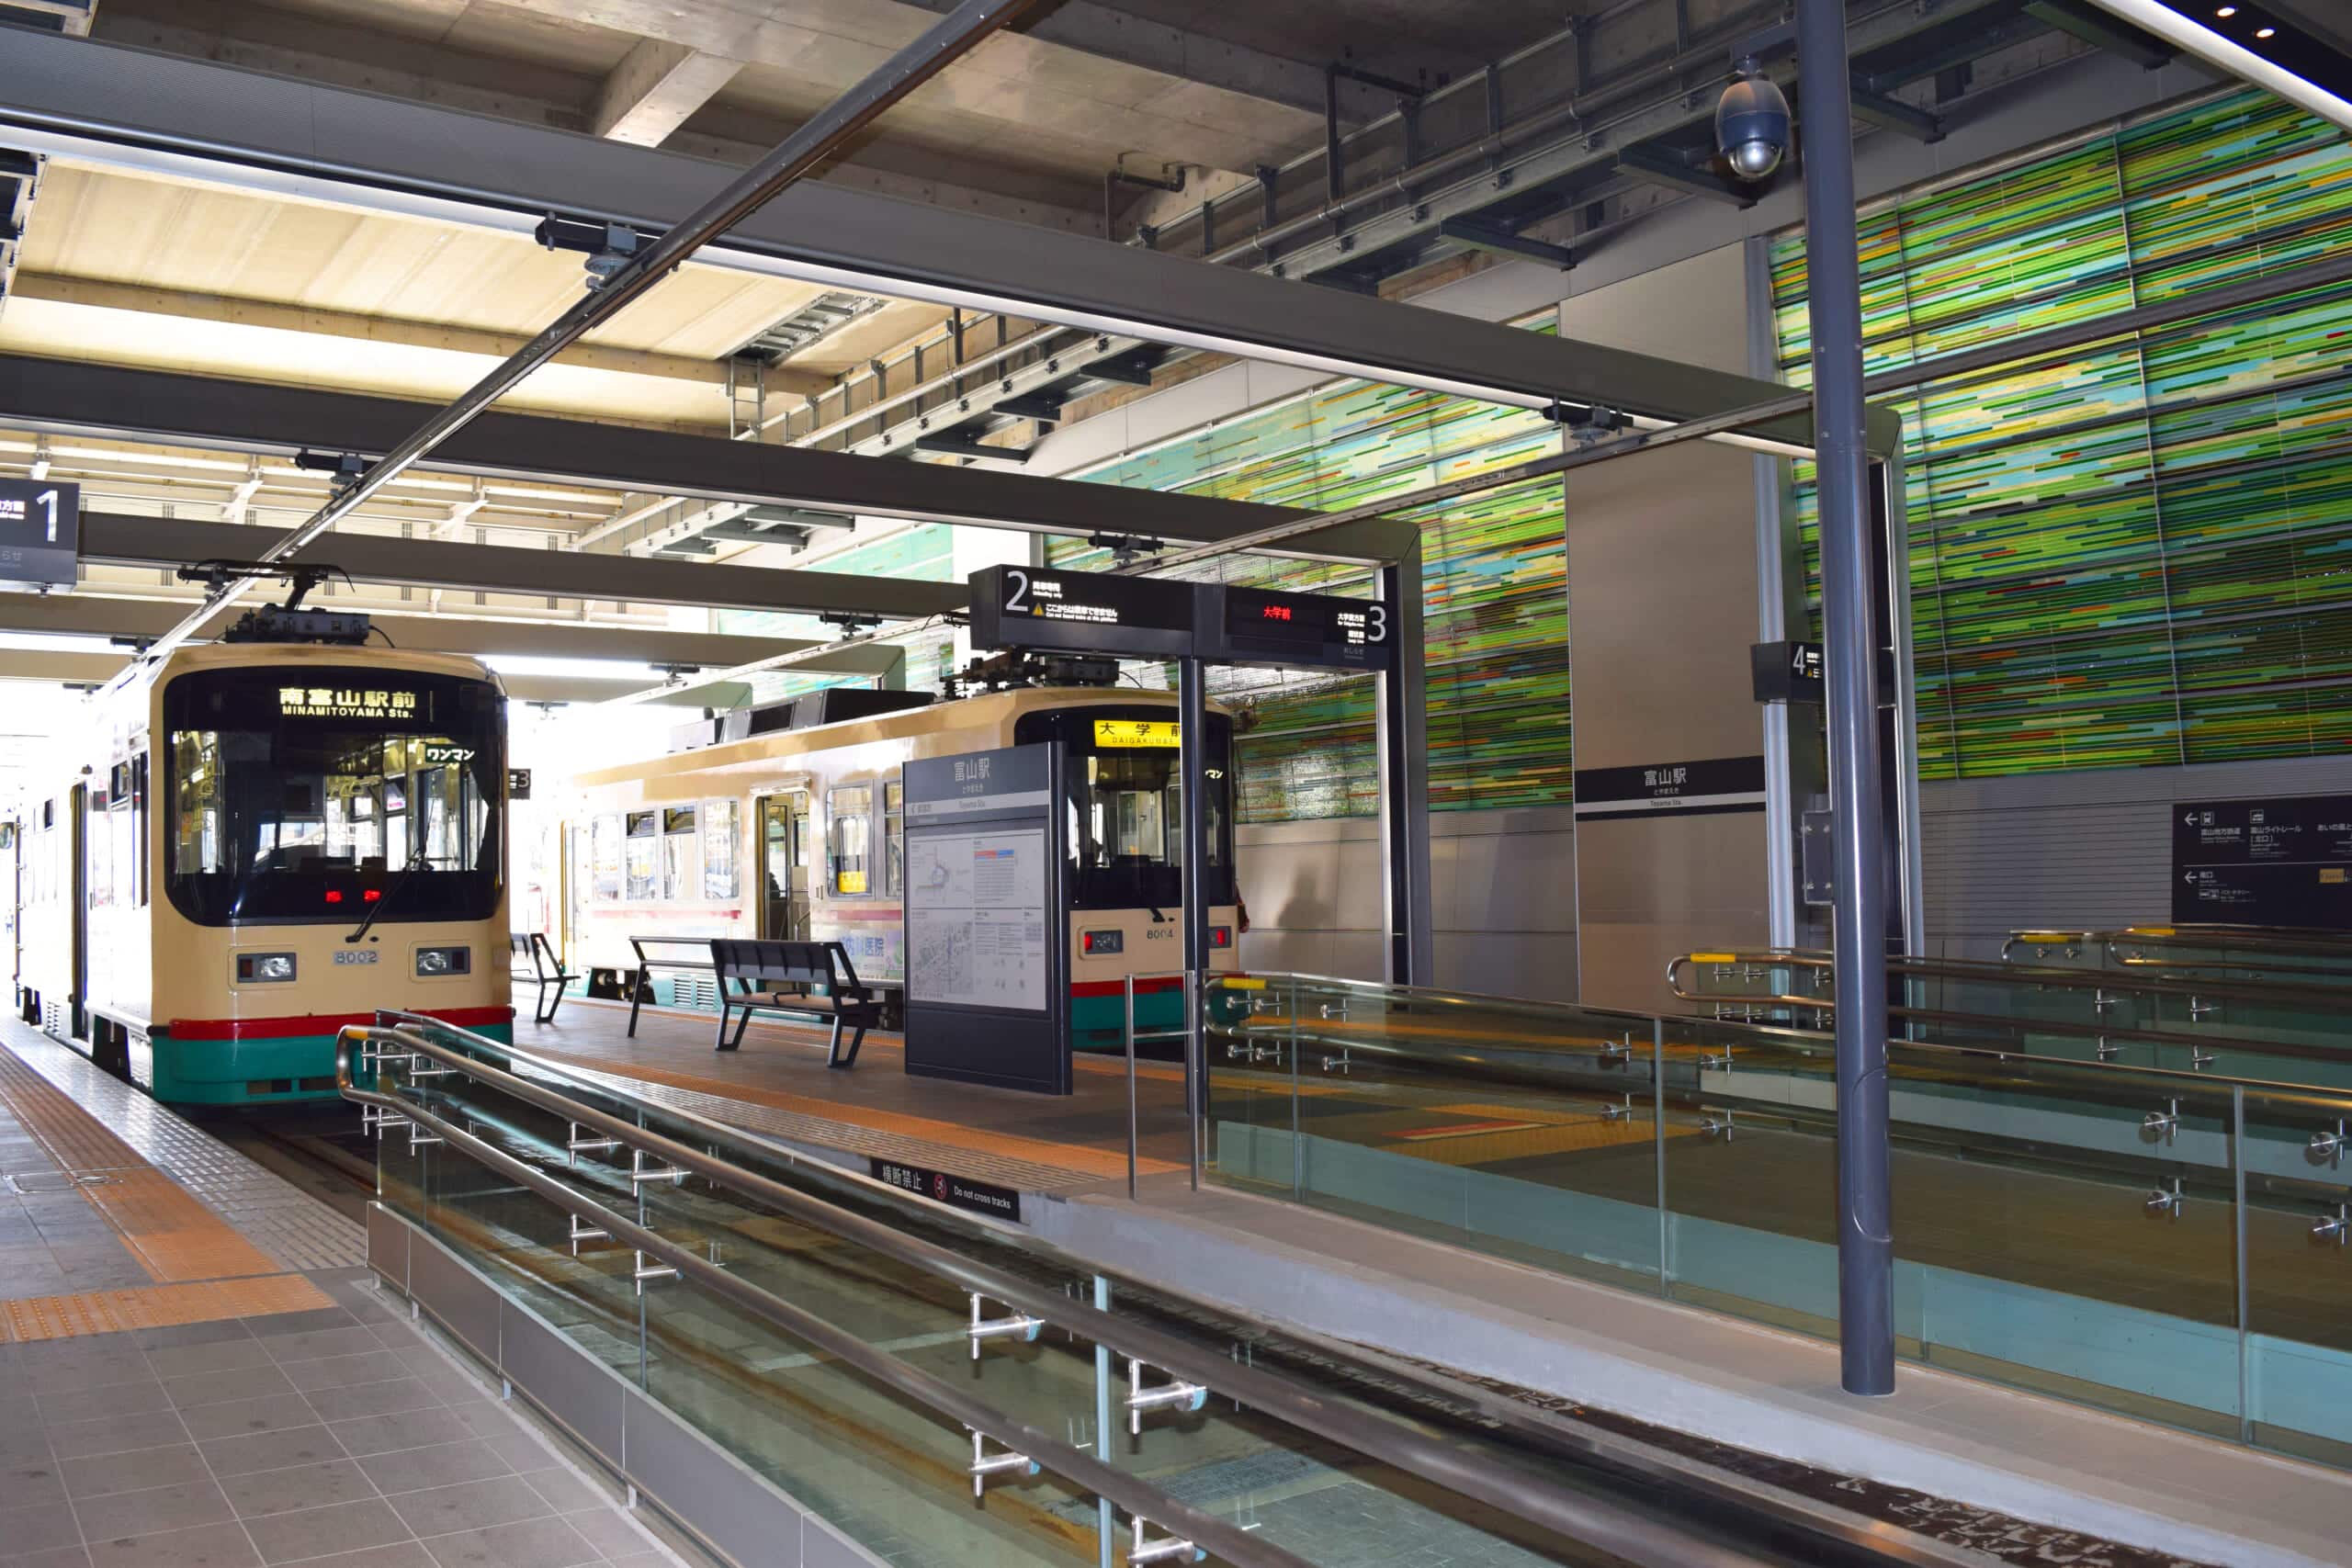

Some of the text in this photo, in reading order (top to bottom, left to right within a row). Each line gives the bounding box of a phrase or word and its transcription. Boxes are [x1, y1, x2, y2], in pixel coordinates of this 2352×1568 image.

[0, 500, 25, 513] 方面
[37, 490, 58, 542] 1
[1006, 570, 1028, 612] 2
[1263, 606, 1292, 621] 大学前
[1368, 605, 1386, 642] 3
[1793, 645, 1805, 675] 4
[278, 688, 416, 708] 南富山駅前
[282, 705, 384, 717] MINAMITOYAMA
[1099, 723, 1180, 738] 大学前
[426, 749, 475, 761] ワンマン
[518, 771, 529, 787] 3
[955, 757, 990, 782] 富山駅
[1205, 770, 1223, 779] マン
[1645, 767, 1687, 786] 富山駅
[336, 952, 378, 964] 8002
[882, 1164, 922, 1190] 横断禁止
[954, 1185, 1011, 1209] Do not cross tracks
